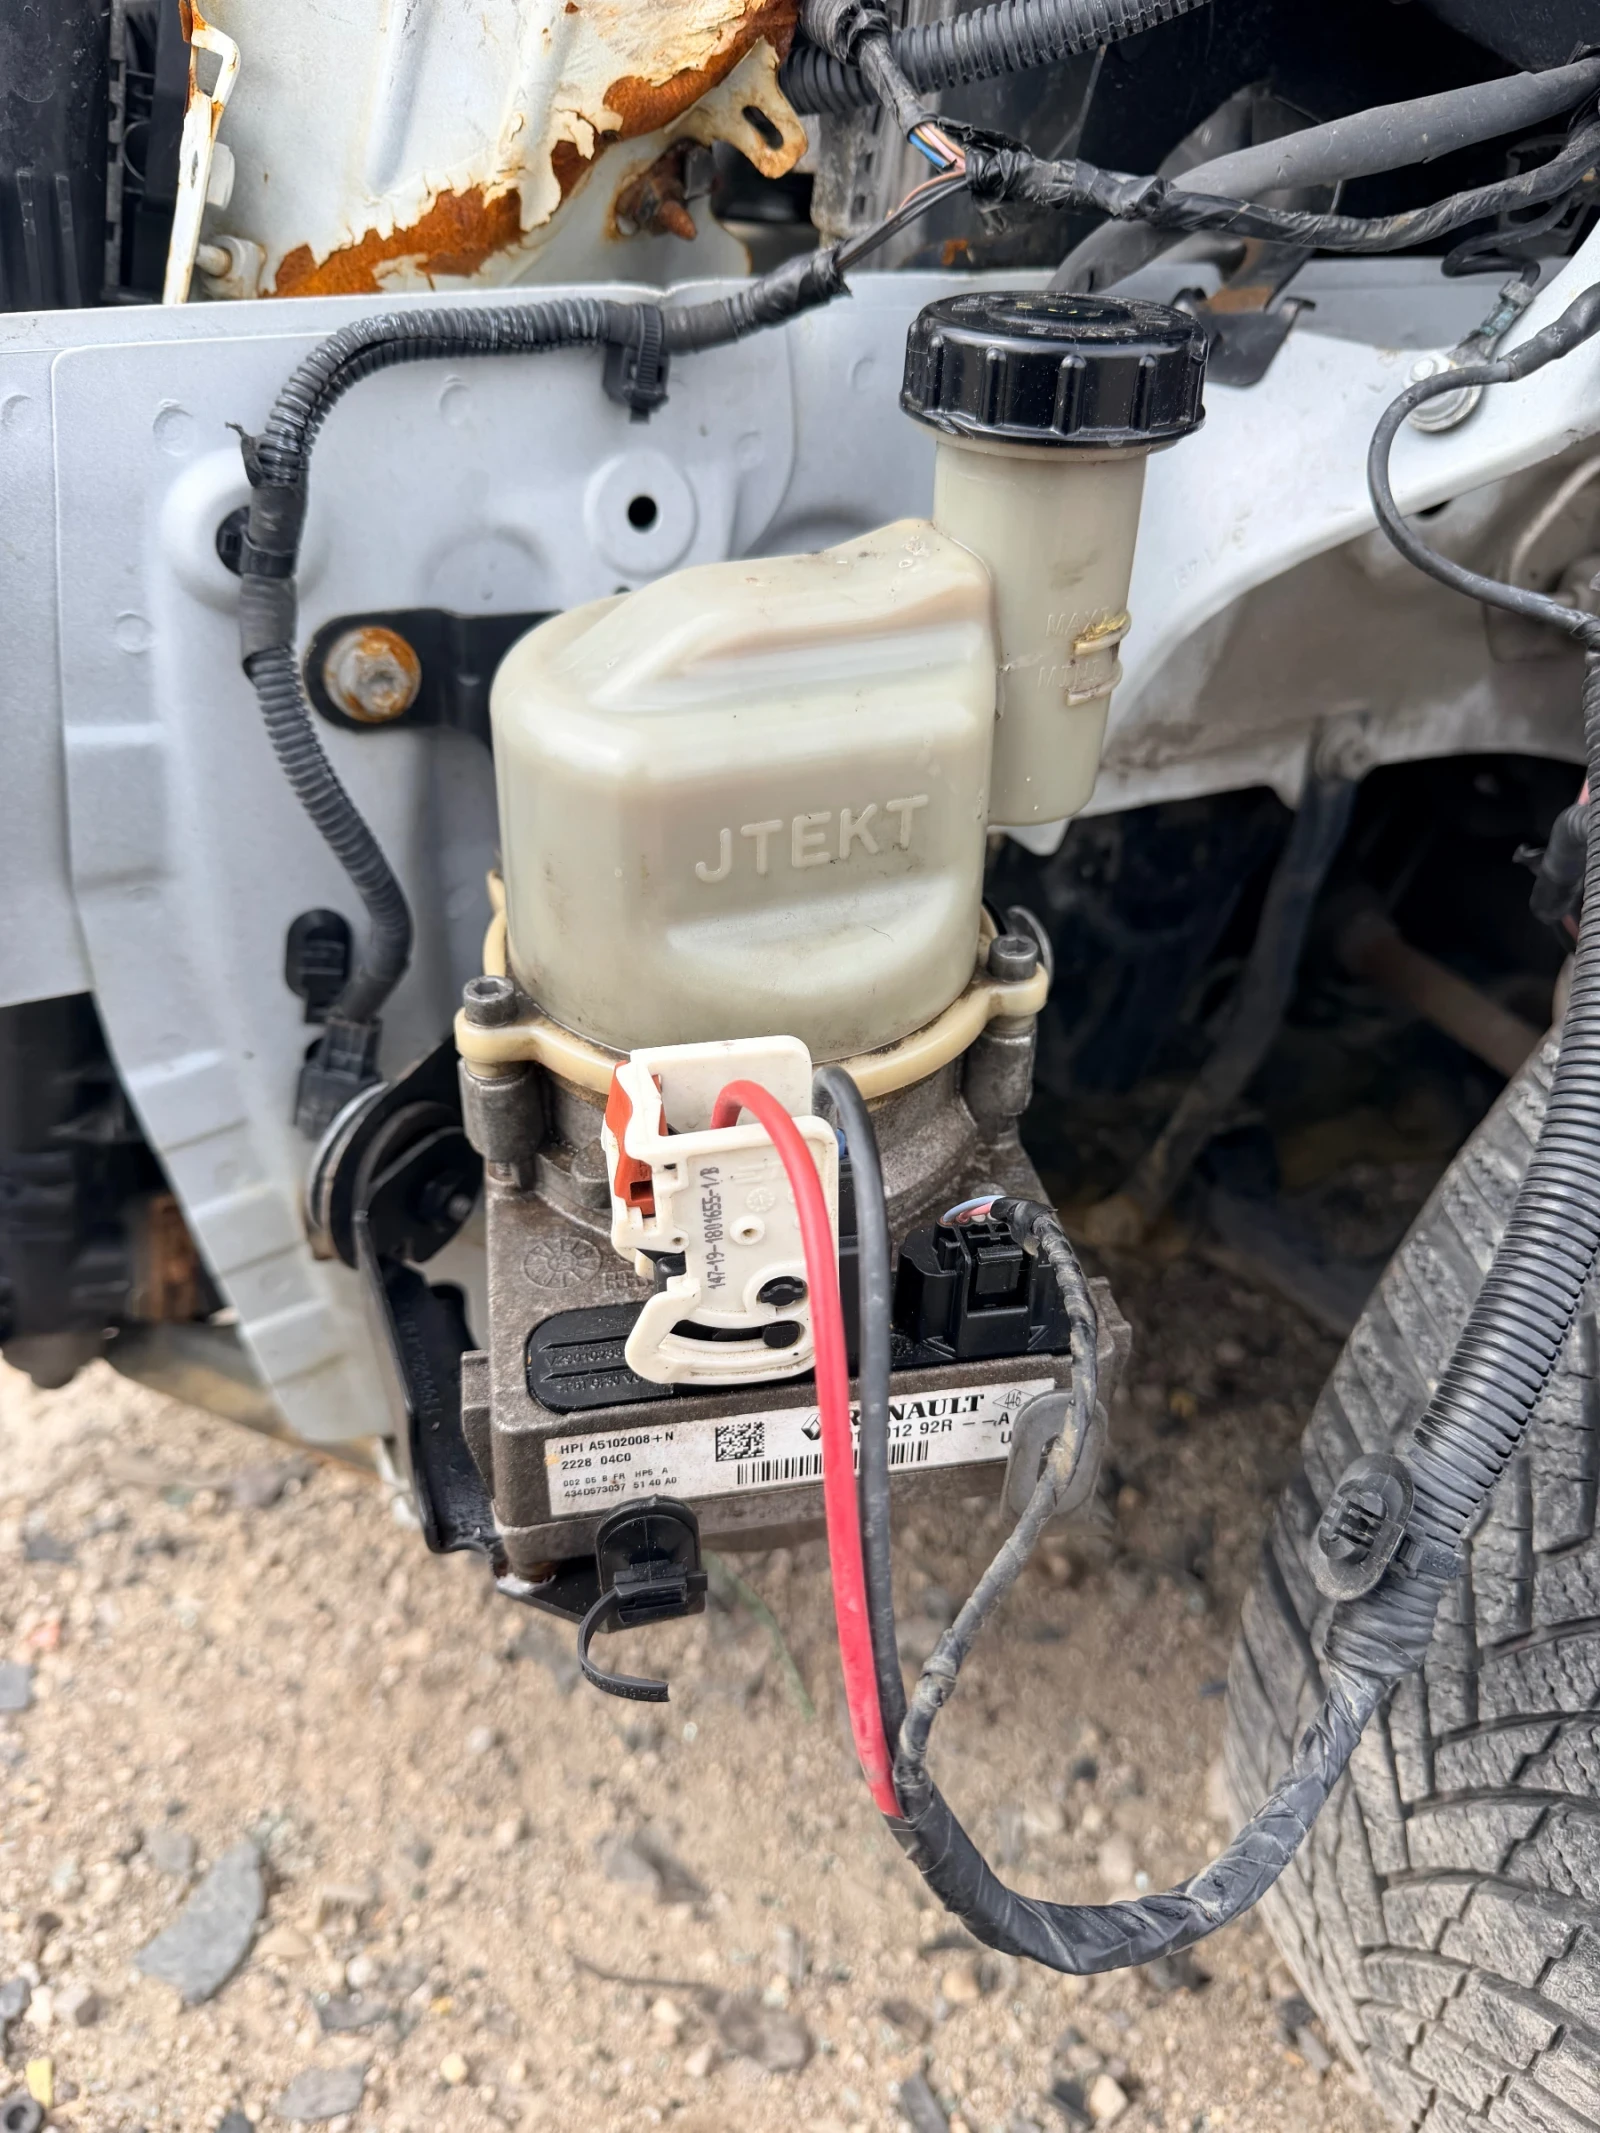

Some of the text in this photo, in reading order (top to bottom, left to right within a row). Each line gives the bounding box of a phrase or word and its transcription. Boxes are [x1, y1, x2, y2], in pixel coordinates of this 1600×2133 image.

[695, 794, 929, 883] JTEKT
[848, 1393, 985, 1426] RNAULT
[919, 1418, 953, 1435] 92R
[560, 1443, 584, 1455] HPI
[561, 1457, 592, 1470] 2228
[633, 1480, 645, 1489] 51
